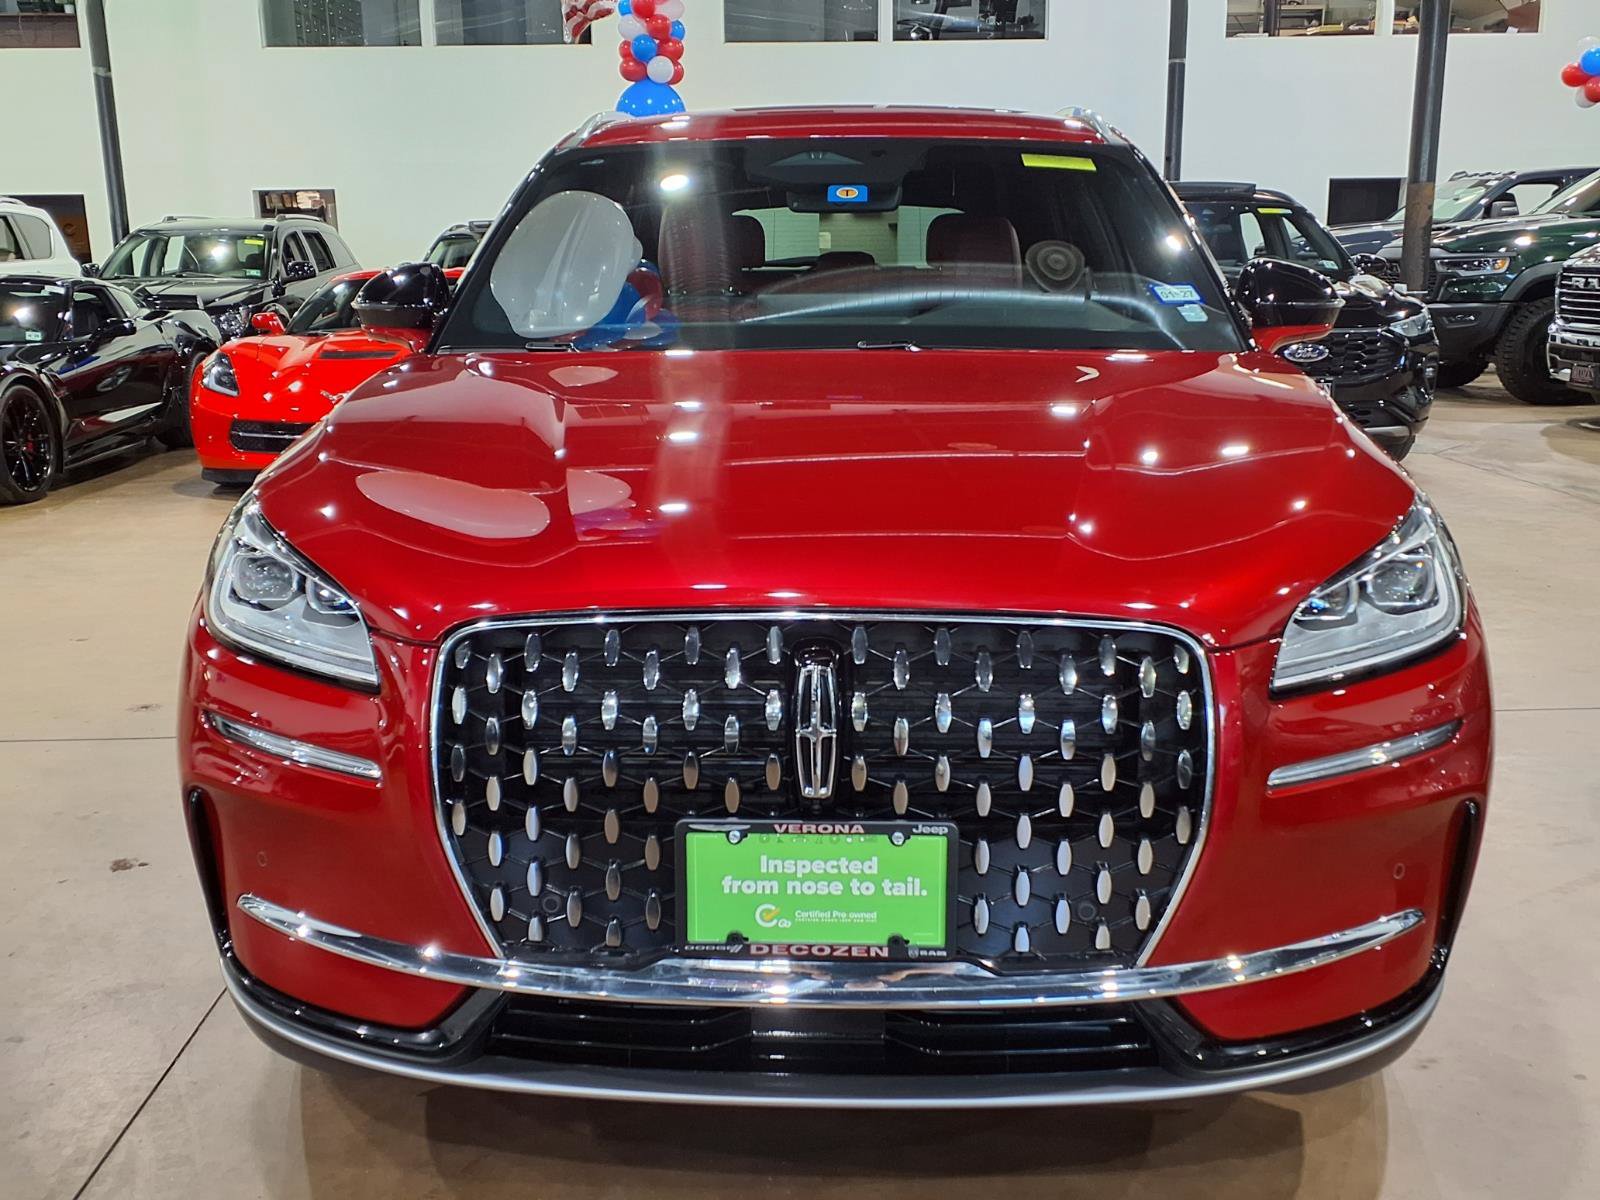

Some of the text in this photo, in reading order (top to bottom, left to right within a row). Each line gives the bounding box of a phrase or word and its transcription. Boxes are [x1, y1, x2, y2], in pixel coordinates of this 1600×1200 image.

[1571, 277, 1600, 289] RA
[773, 824, 865, 834] VERONA
[912, 825, 949, 835] Jeep
[760, 855, 878, 878] Inspected
[722, 876, 928, 897] from nose to tail.
[795, 910, 831, 918] Certified
[749, 944, 889, 957] DECOZEN
